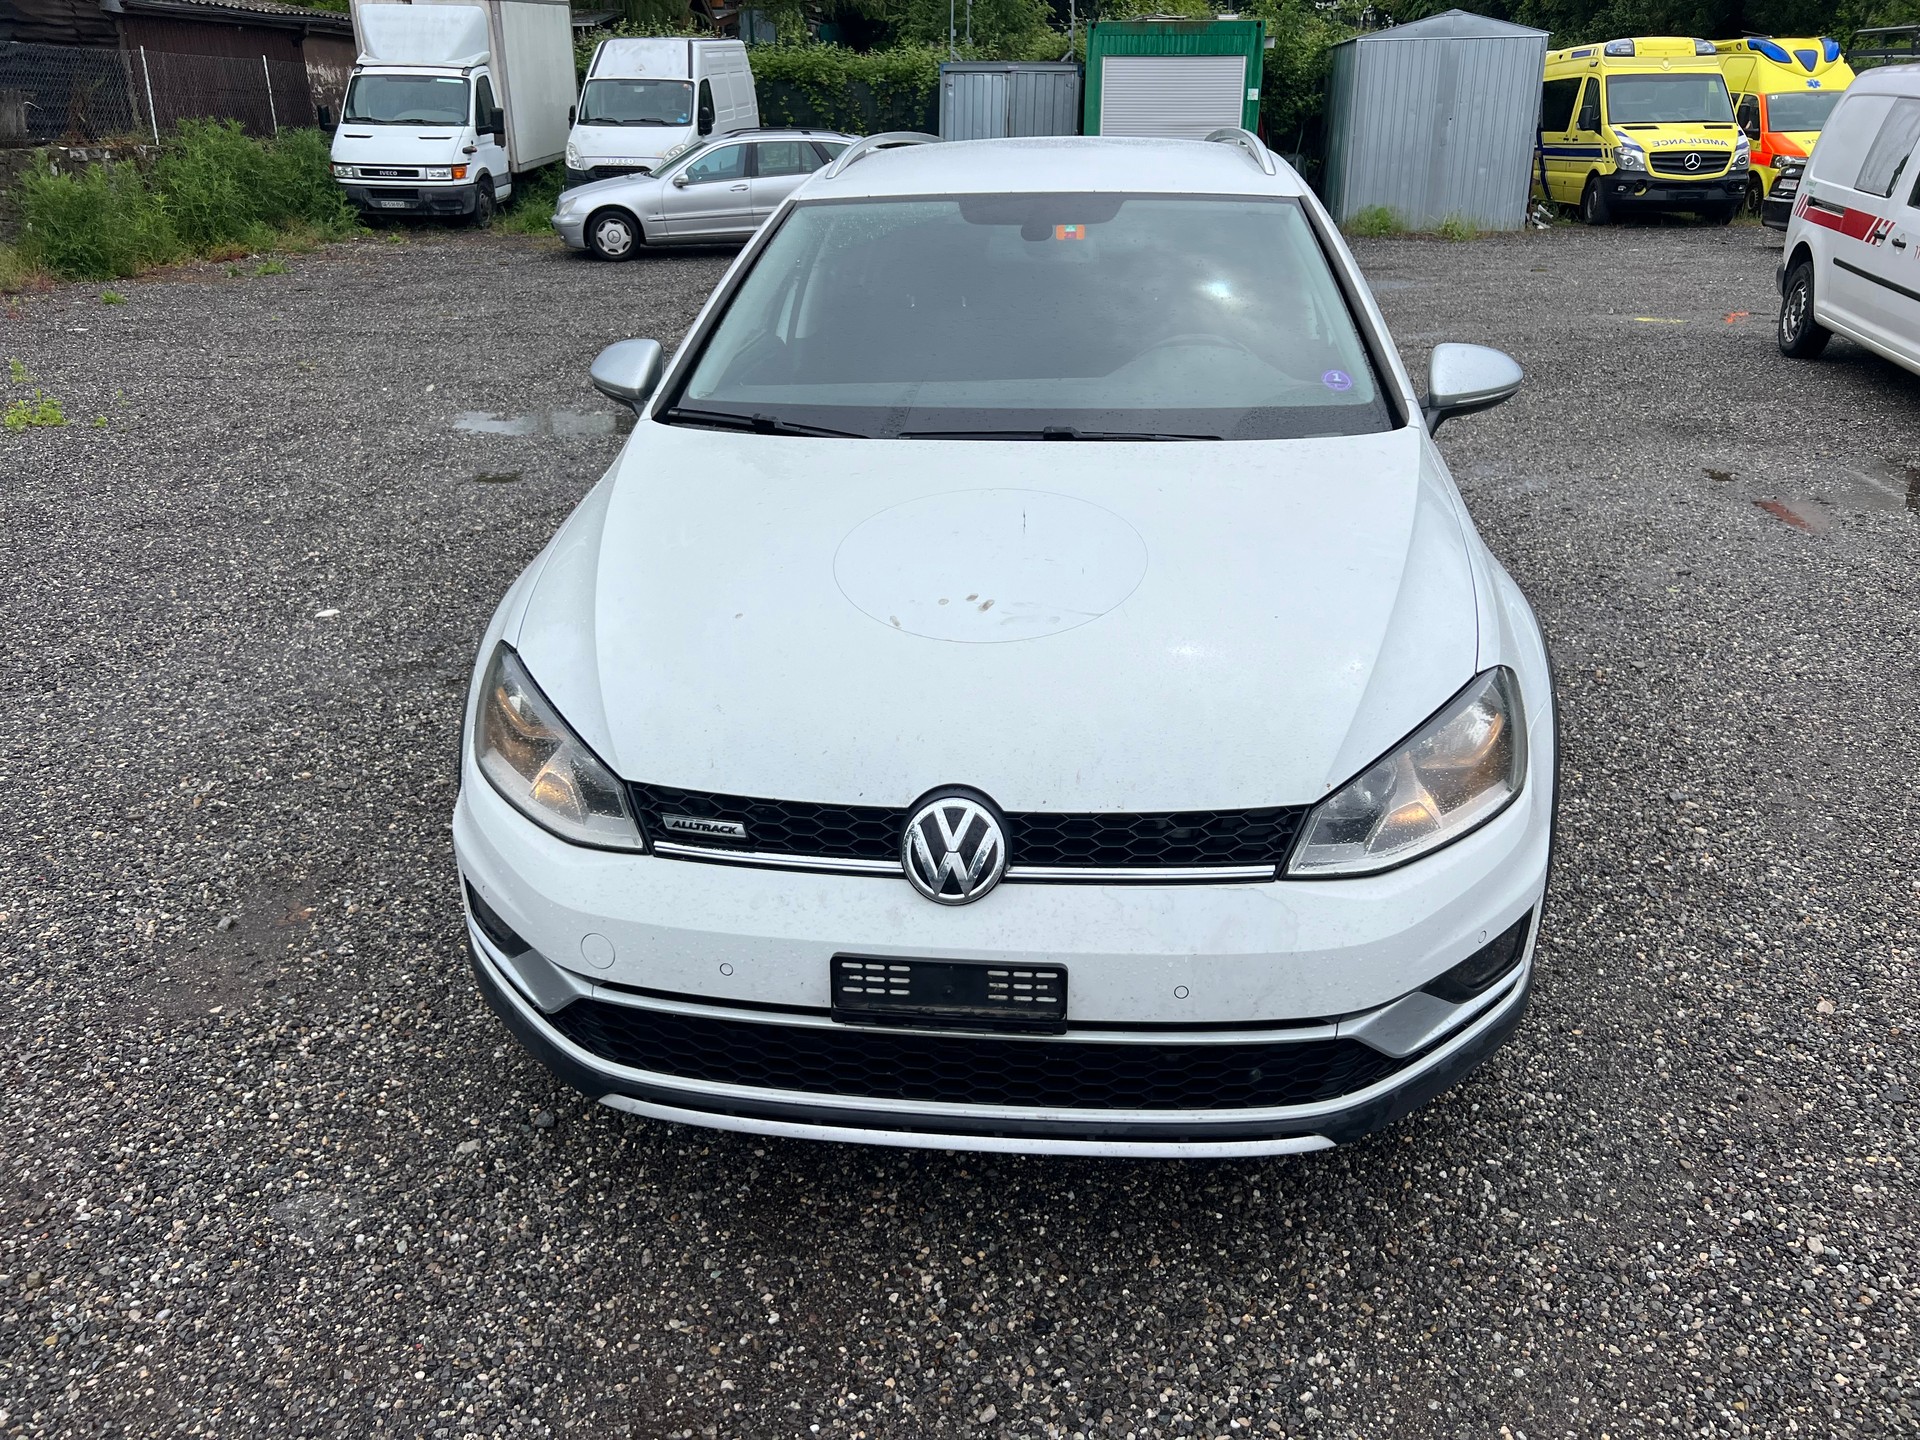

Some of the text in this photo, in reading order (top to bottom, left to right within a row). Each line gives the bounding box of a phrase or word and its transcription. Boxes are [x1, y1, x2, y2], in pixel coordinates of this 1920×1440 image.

[606, 158, 634, 166] IVECO
[1332, 373, 1342, 382] 1
[672, 820, 737, 834] ALLTRACK
